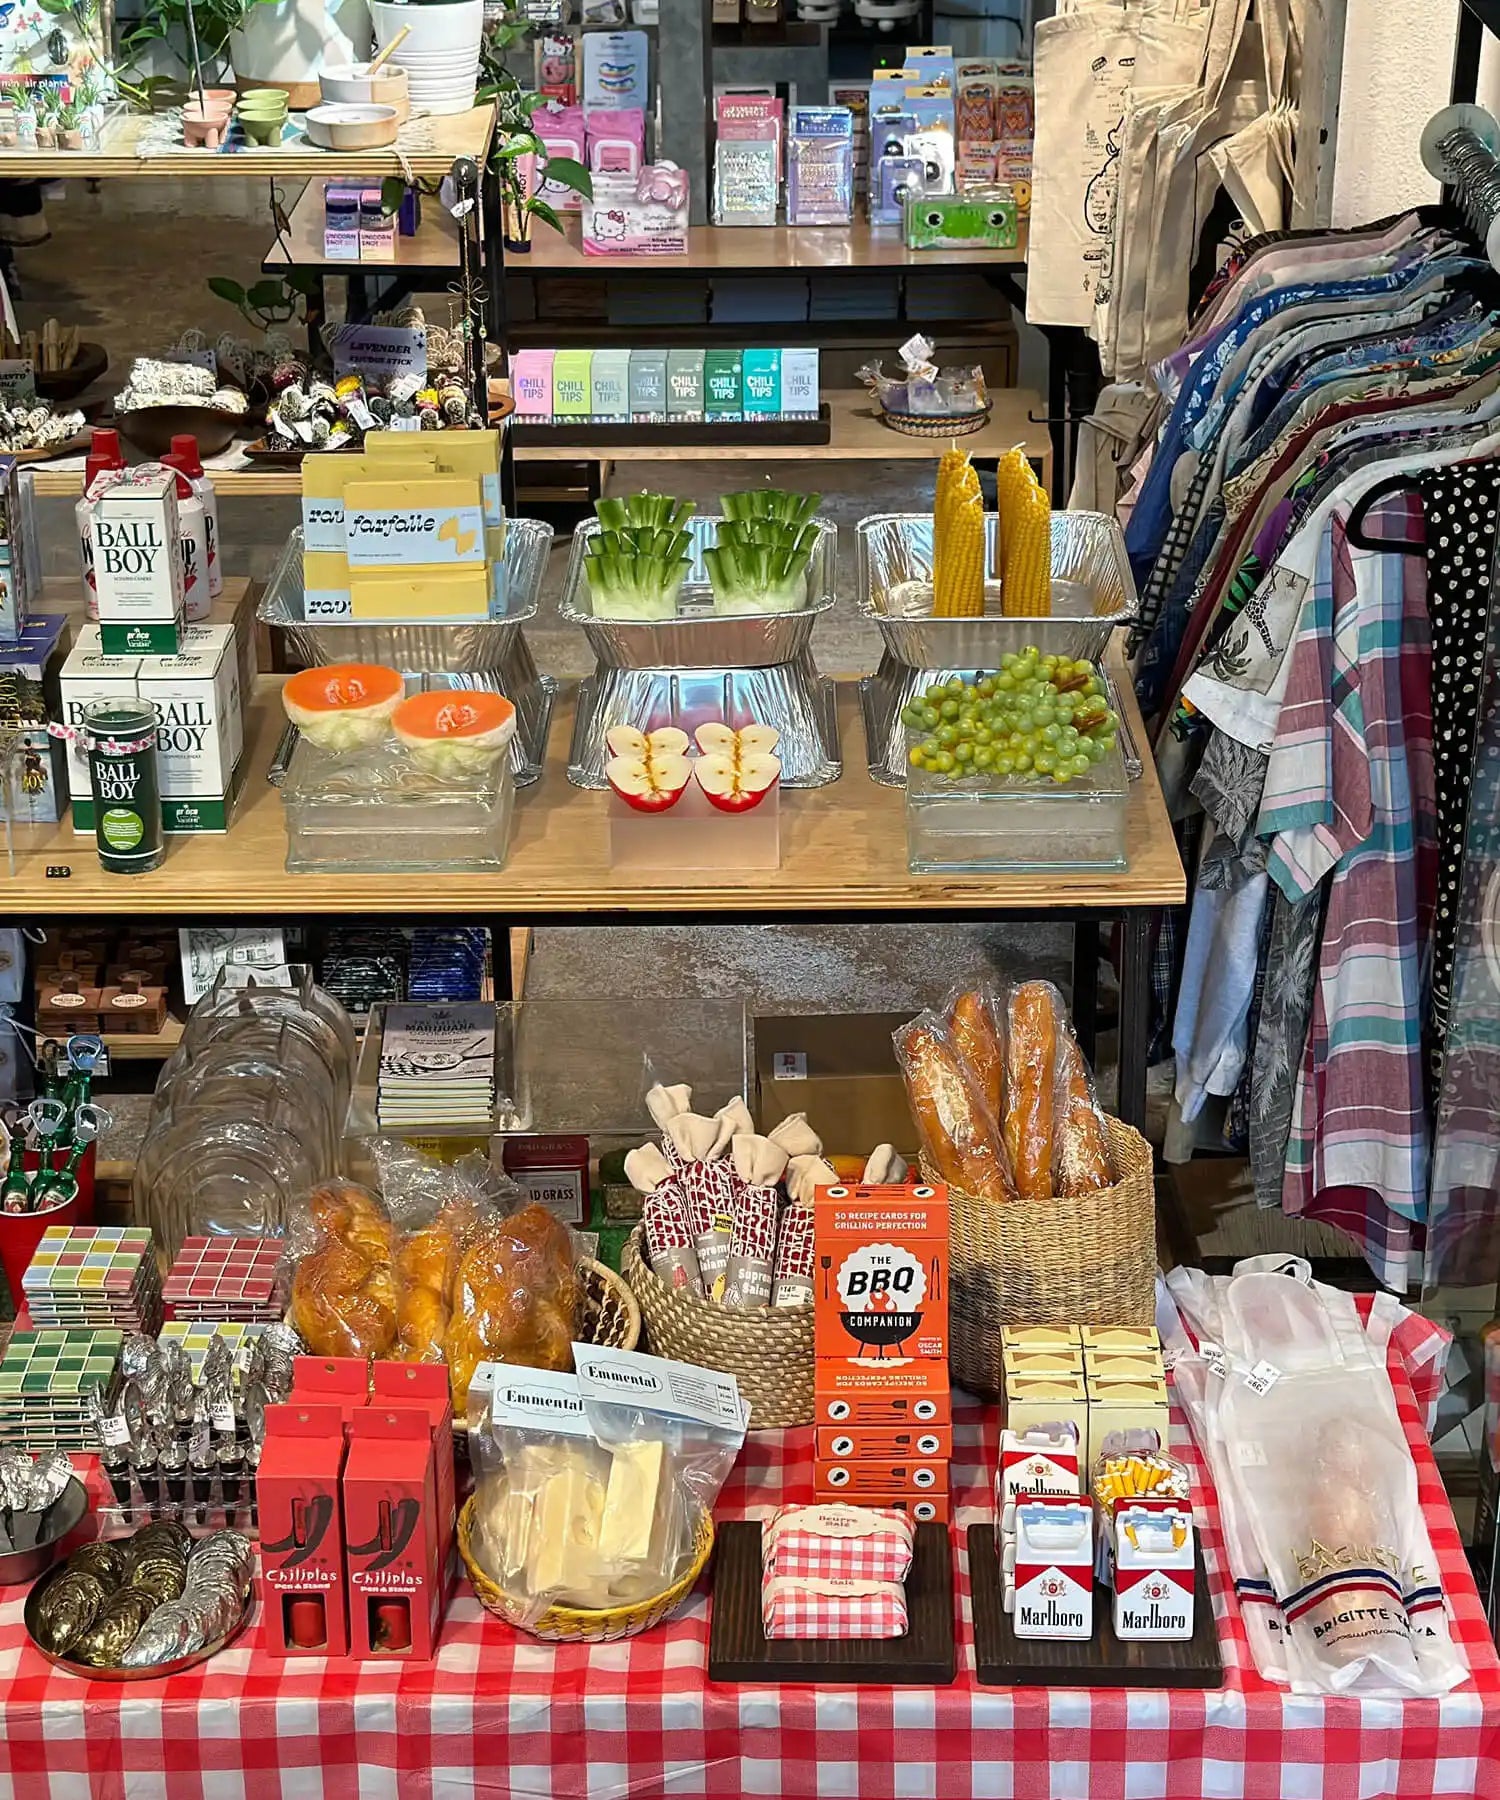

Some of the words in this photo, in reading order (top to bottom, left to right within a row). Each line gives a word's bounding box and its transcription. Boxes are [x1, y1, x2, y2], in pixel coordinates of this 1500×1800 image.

[350, 342, 412, 354] LAVENDER
[386, 358, 414, 366] STICK
[519, 378, 546, 389] CHILL
[557, 380, 585, 392] CHILL
[594, 380, 623, 391] CHILL
[670, 375, 700, 388] CHILL
[709, 377, 738, 389] CHILL
[746, 375, 776, 388] CHILL
[522, 388, 544, 399] TIPS
[559, 391, 583, 403] TIPS
[598, 391, 620, 403] TIPS
[674, 387, 697, 398] TIPS
[713, 388, 735, 400] TIPS
[750, 387, 773, 398] TIPS
[349, 513, 437, 538] farfalle
[95, 522, 163, 548] BALL
[104, 548, 158, 574] BOY
[153, 701, 212, 726] BALL
[156, 727, 208, 751] BOY
[95, 760, 141, 782] BALL
[100, 780, 138, 801] BOY
[405, 1023, 476, 1032] MARIJUANA
[543, 1188, 574, 1201] GRASS
[834, 1212, 847, 1220] 50
[848, 1212, 879, 1220] RECIPE
[880, 1212, 909, 1220] CARDS
[910, 1212, 927, 1220] FOR
[834, 1222, 874, 1230] GRILLING
[875, 1222, 927, 1230] PERFECTION
[870, 1256, 892, 1265] THE
[846, 1266, 915, 1297] BBQ
[849, 1315, 913, 1327] COMPANION
[587, 1365, 658, 1390] Emmental
[505, 1389, 583, 1412] Emmental
[1291, 1537, 1329, 1564] LA
[265, 1569, 338, 1582] Chiliplas
[351, 1571, 424, 1585] Chiliplas
[1020, 1600, 1084, 1628] Marlboro
[1122, 1603, 1186, 1629] Marlboro
[1312, 1607, 1390, 1639] BRIGITTE
